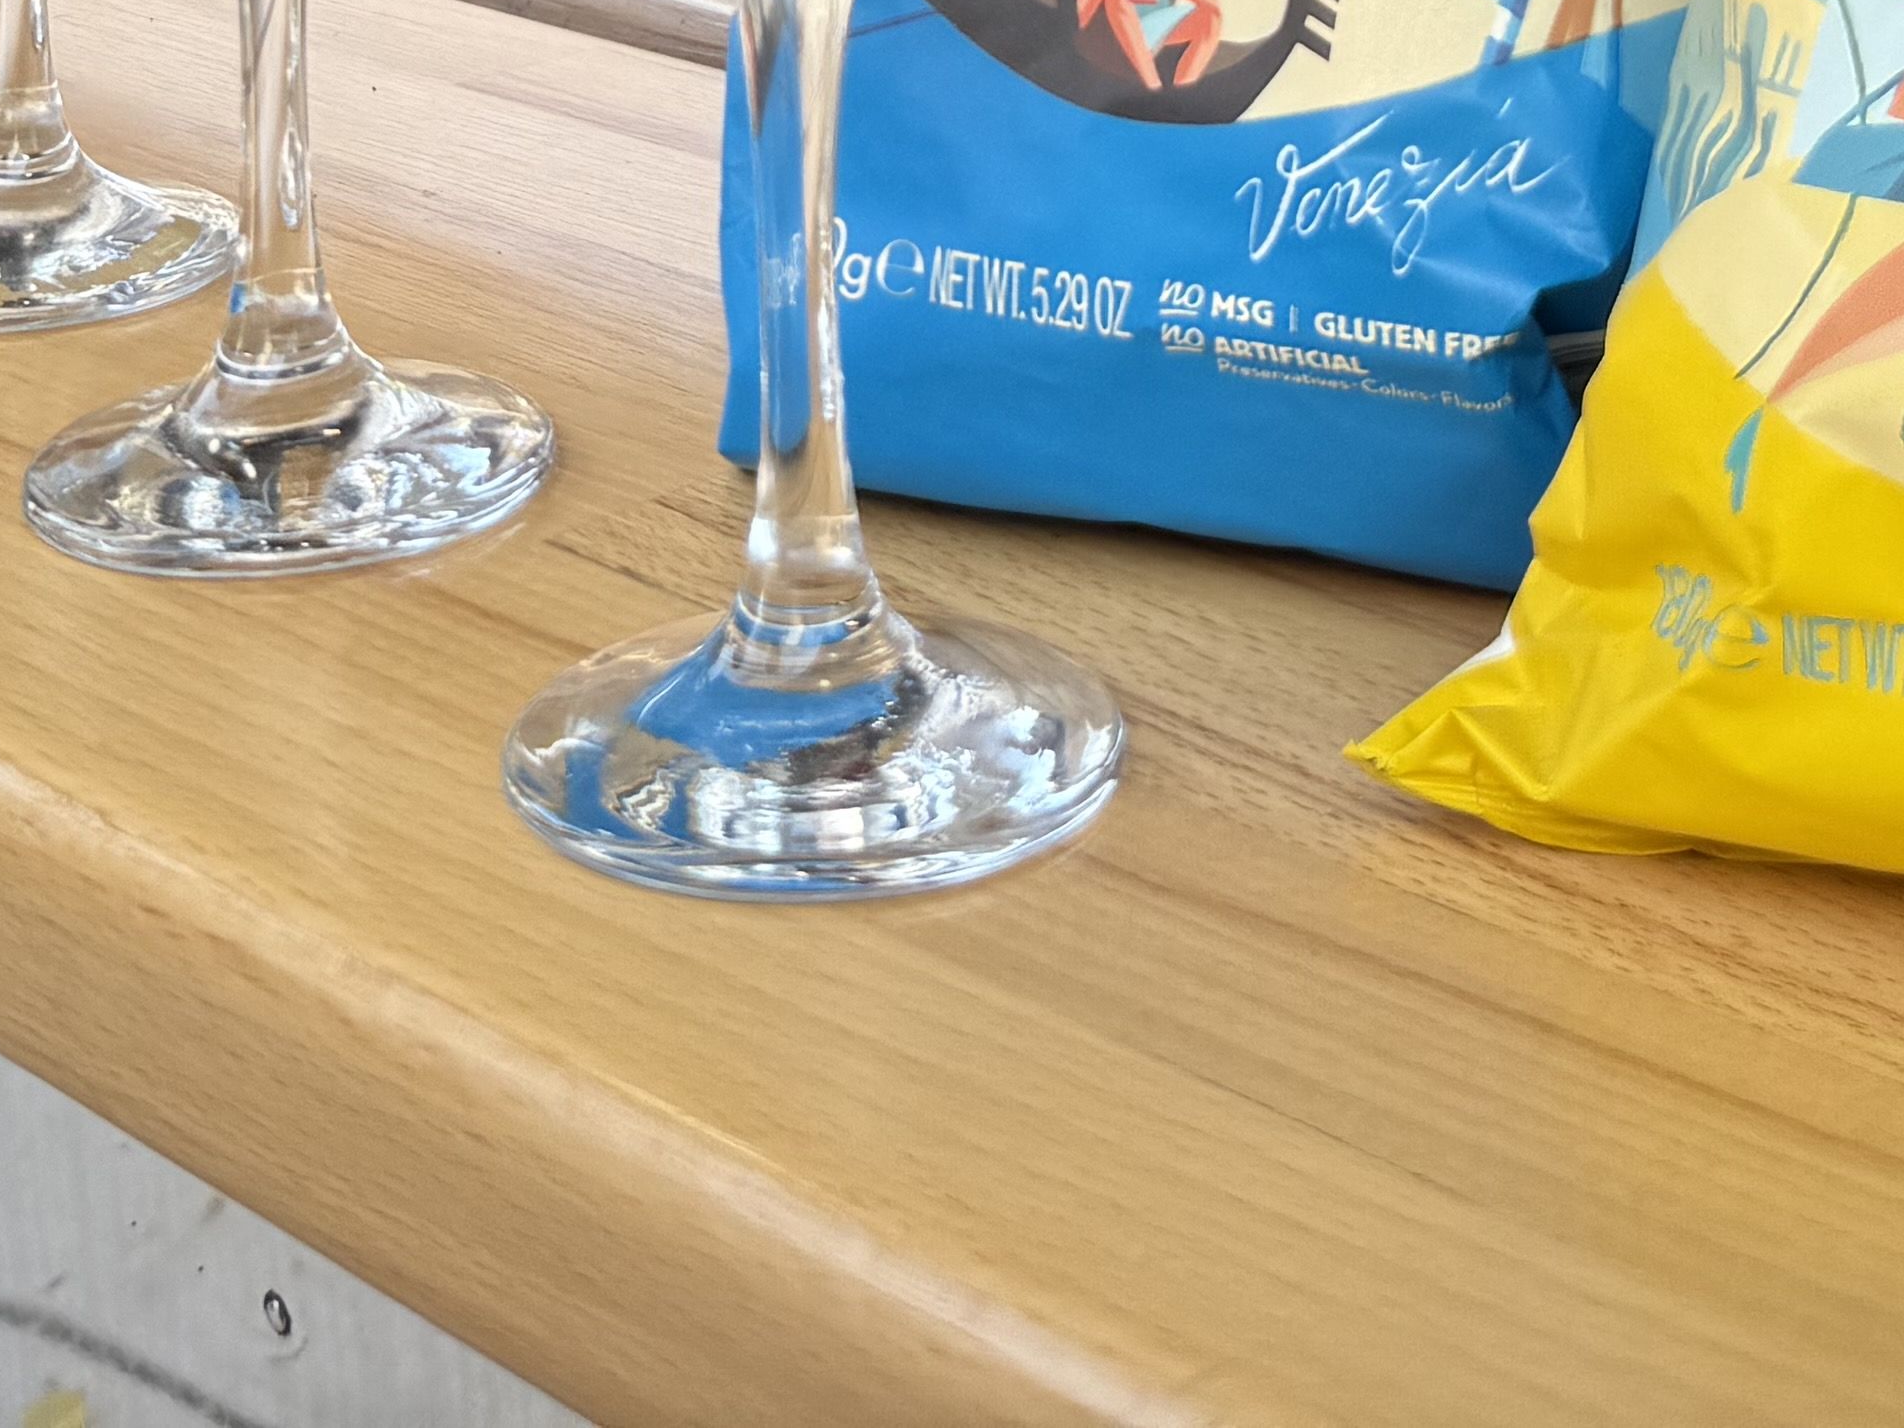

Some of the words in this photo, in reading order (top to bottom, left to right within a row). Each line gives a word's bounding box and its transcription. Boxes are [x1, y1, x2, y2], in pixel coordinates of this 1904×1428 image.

[929, 245, 981, 311] NET
[982, 258, 1028, 321] WT.
[1030, 267, 1090, 331] 5.29
[1093, 276, 1135, 339] OZ
[1210, 290, 1275, 327] MSG
[1313, 311, 1437, 355] GLUTEN
[1214, 336, 1370, 376] ARTIFICIAL
[1781, 610, 1856, 685] NET
